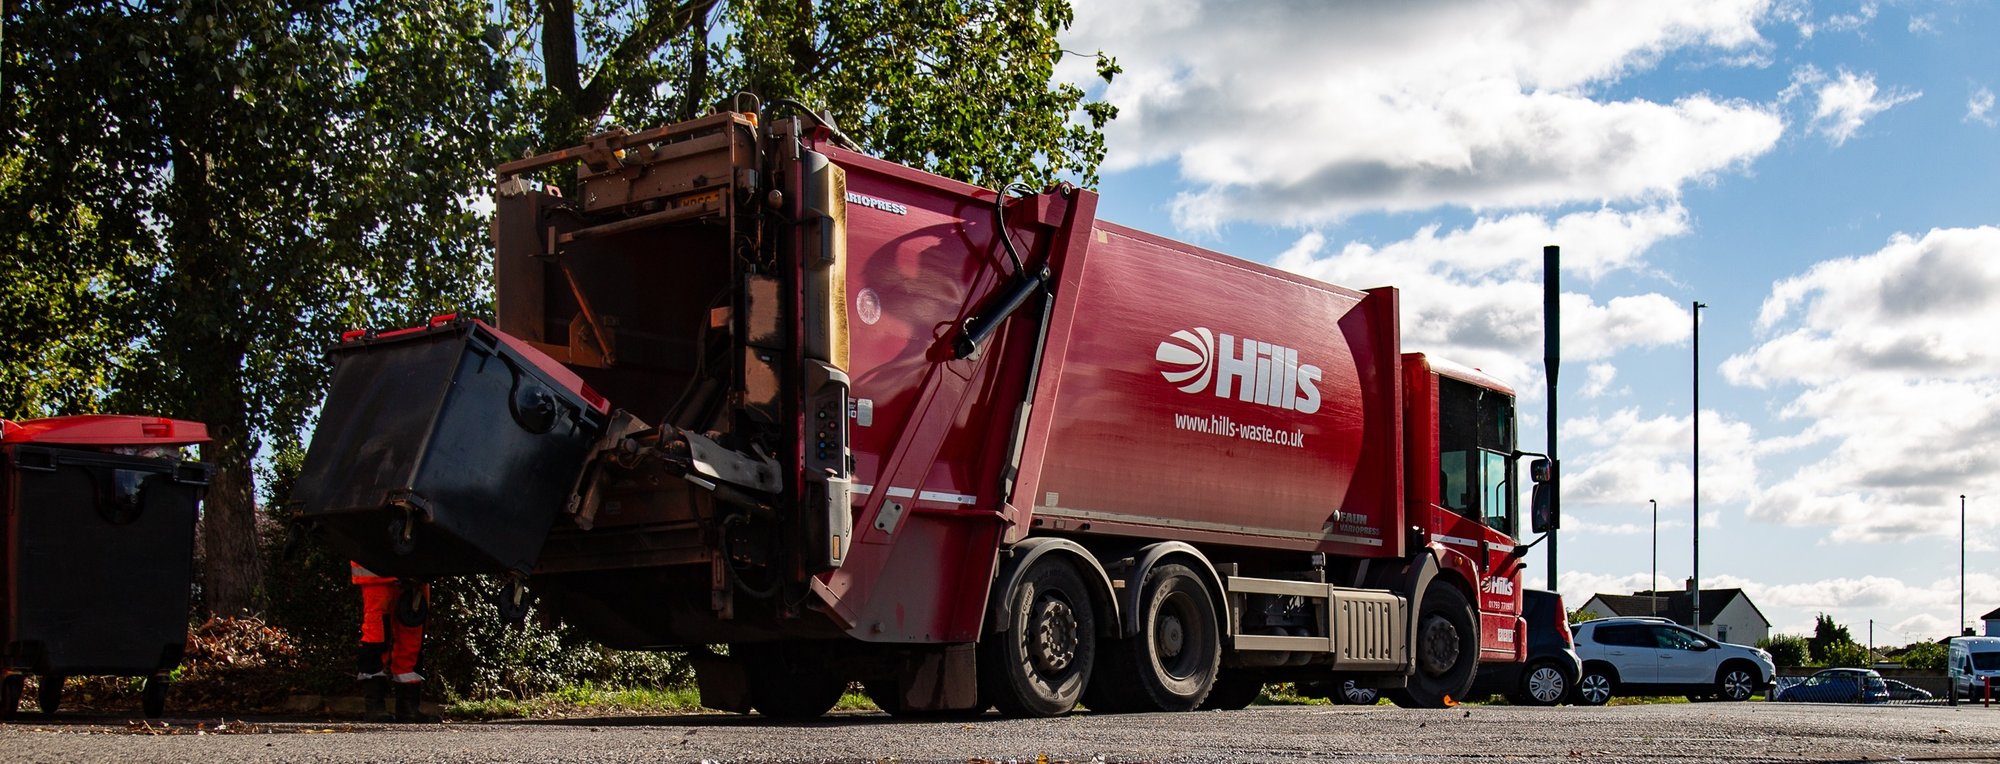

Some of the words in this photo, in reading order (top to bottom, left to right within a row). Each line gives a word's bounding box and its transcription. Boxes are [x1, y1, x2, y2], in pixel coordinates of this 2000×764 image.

[844, 191, 907, 215] ARIOPRESS
[1215, 333, 1322, 414] Hills
[1175, 413, 1304, 448] www.hills-waste.co.uk
[1340, 511, 1368, 525] FAUN
[1491, 576, 1513, 596] Hills
